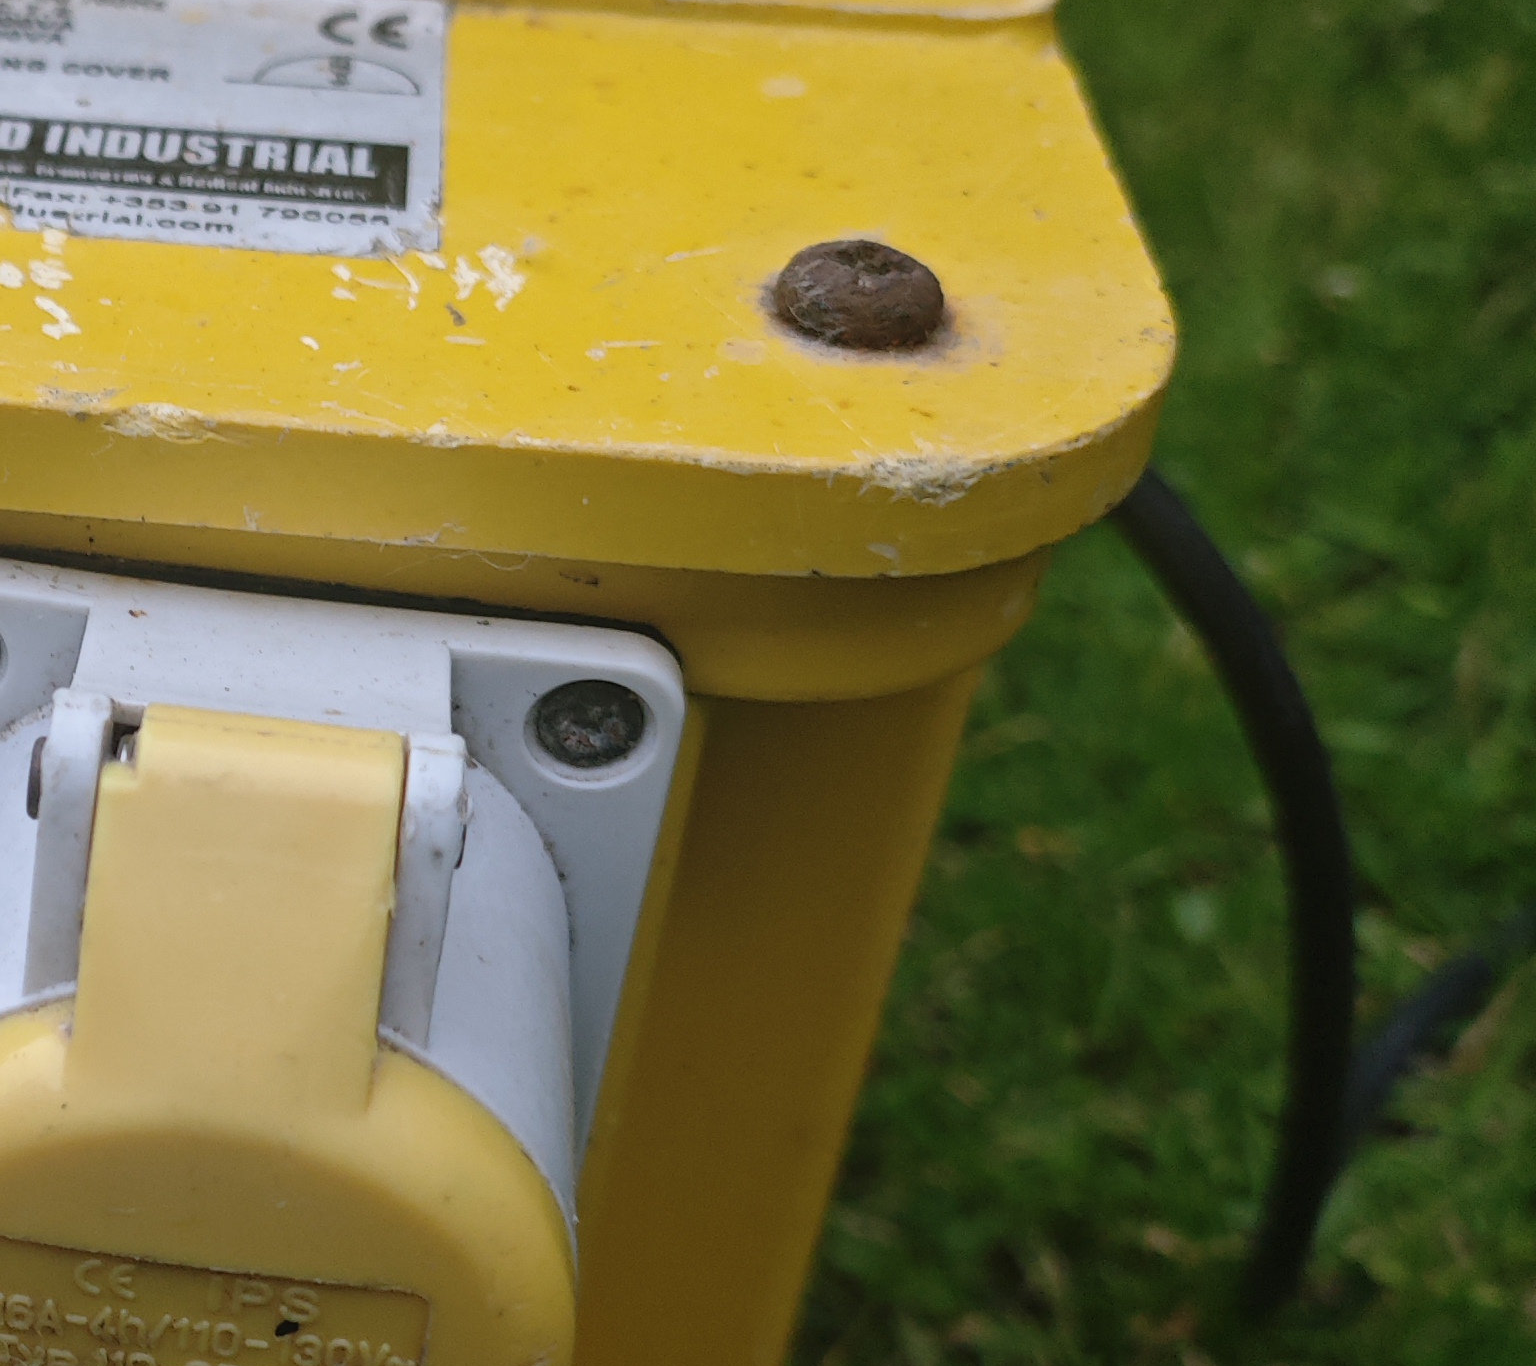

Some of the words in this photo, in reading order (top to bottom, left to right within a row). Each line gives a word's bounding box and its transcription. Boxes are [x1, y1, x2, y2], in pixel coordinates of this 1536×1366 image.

[317, 11, 409, 50] CE
[58, 60, 171, 82] COVER
[43, 123, 376, 179] INDUSTRIAL
[74, 1258, 136, 1300] CE
